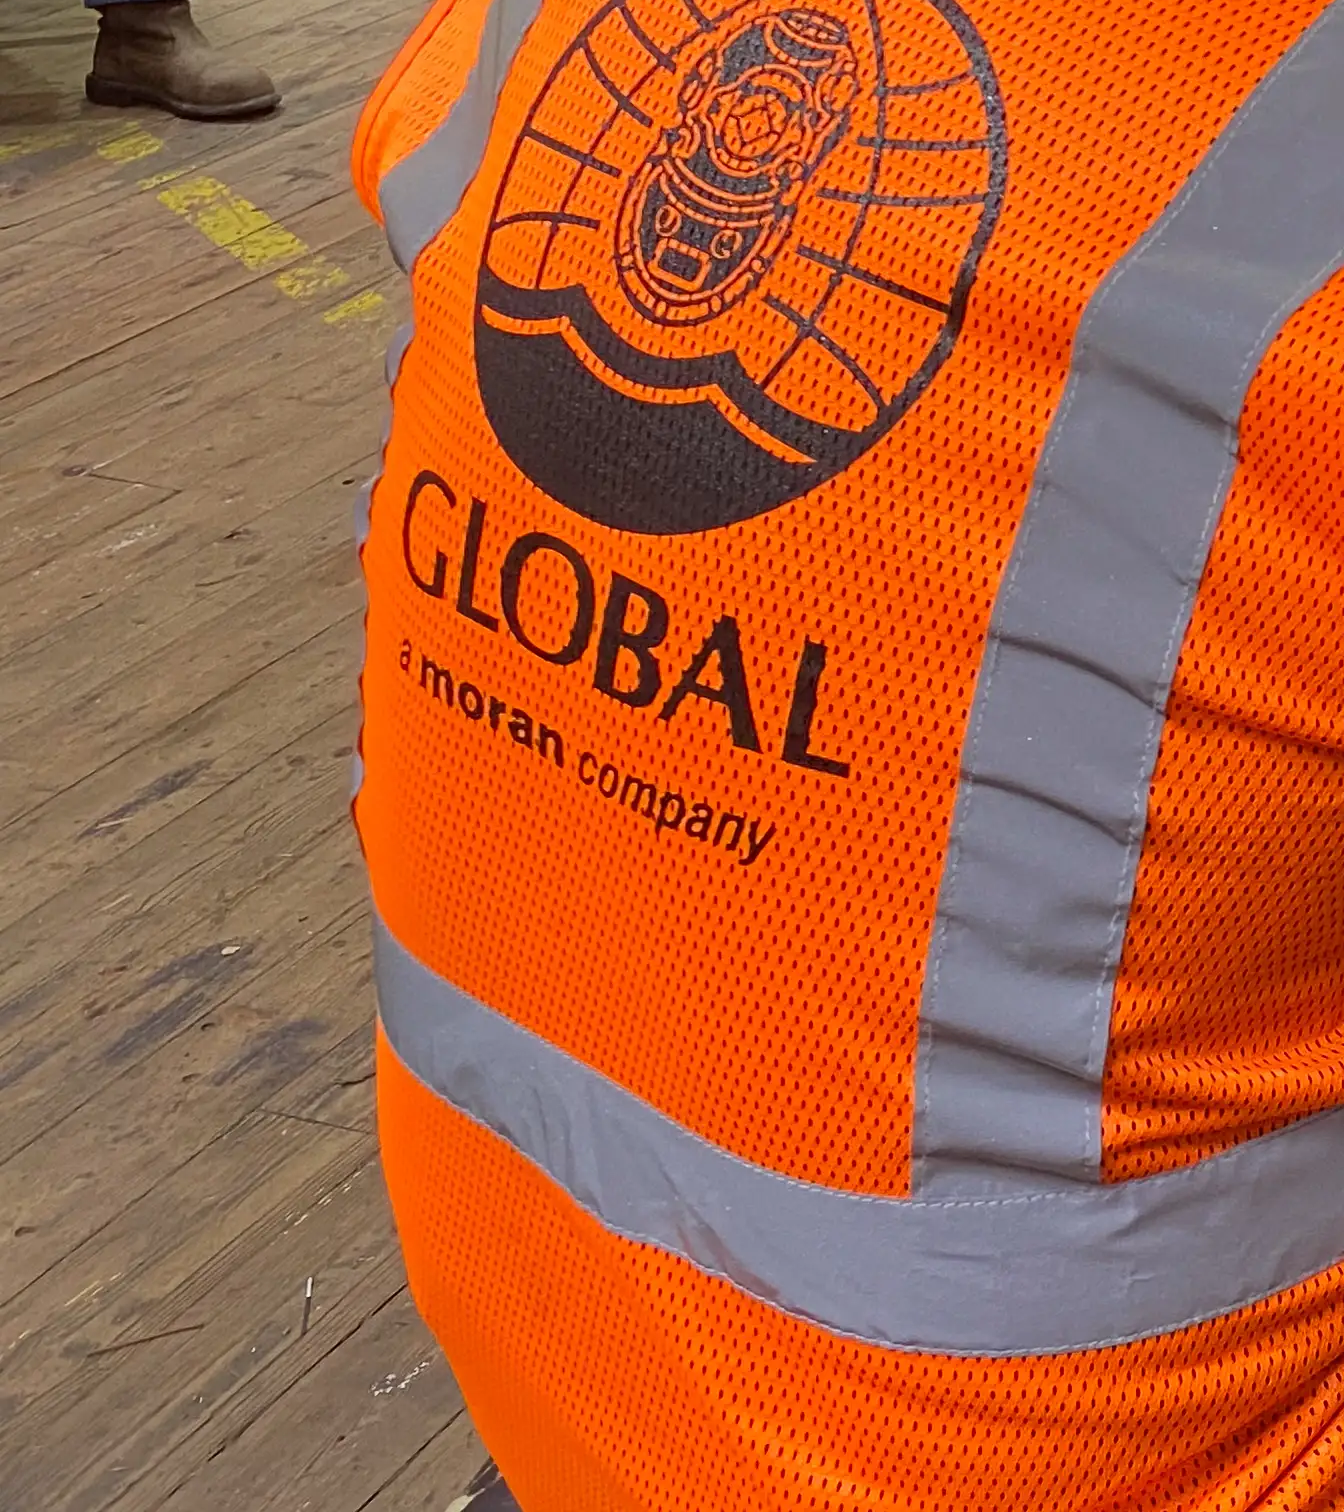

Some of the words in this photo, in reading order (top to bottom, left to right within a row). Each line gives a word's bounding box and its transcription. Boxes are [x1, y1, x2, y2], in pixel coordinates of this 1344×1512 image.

[399, 638, 411, 671] a
[420, 654, 565, 768] moran
[578, 748, 778, 866] company
[402, 469, 850, 779] GLOBAL
